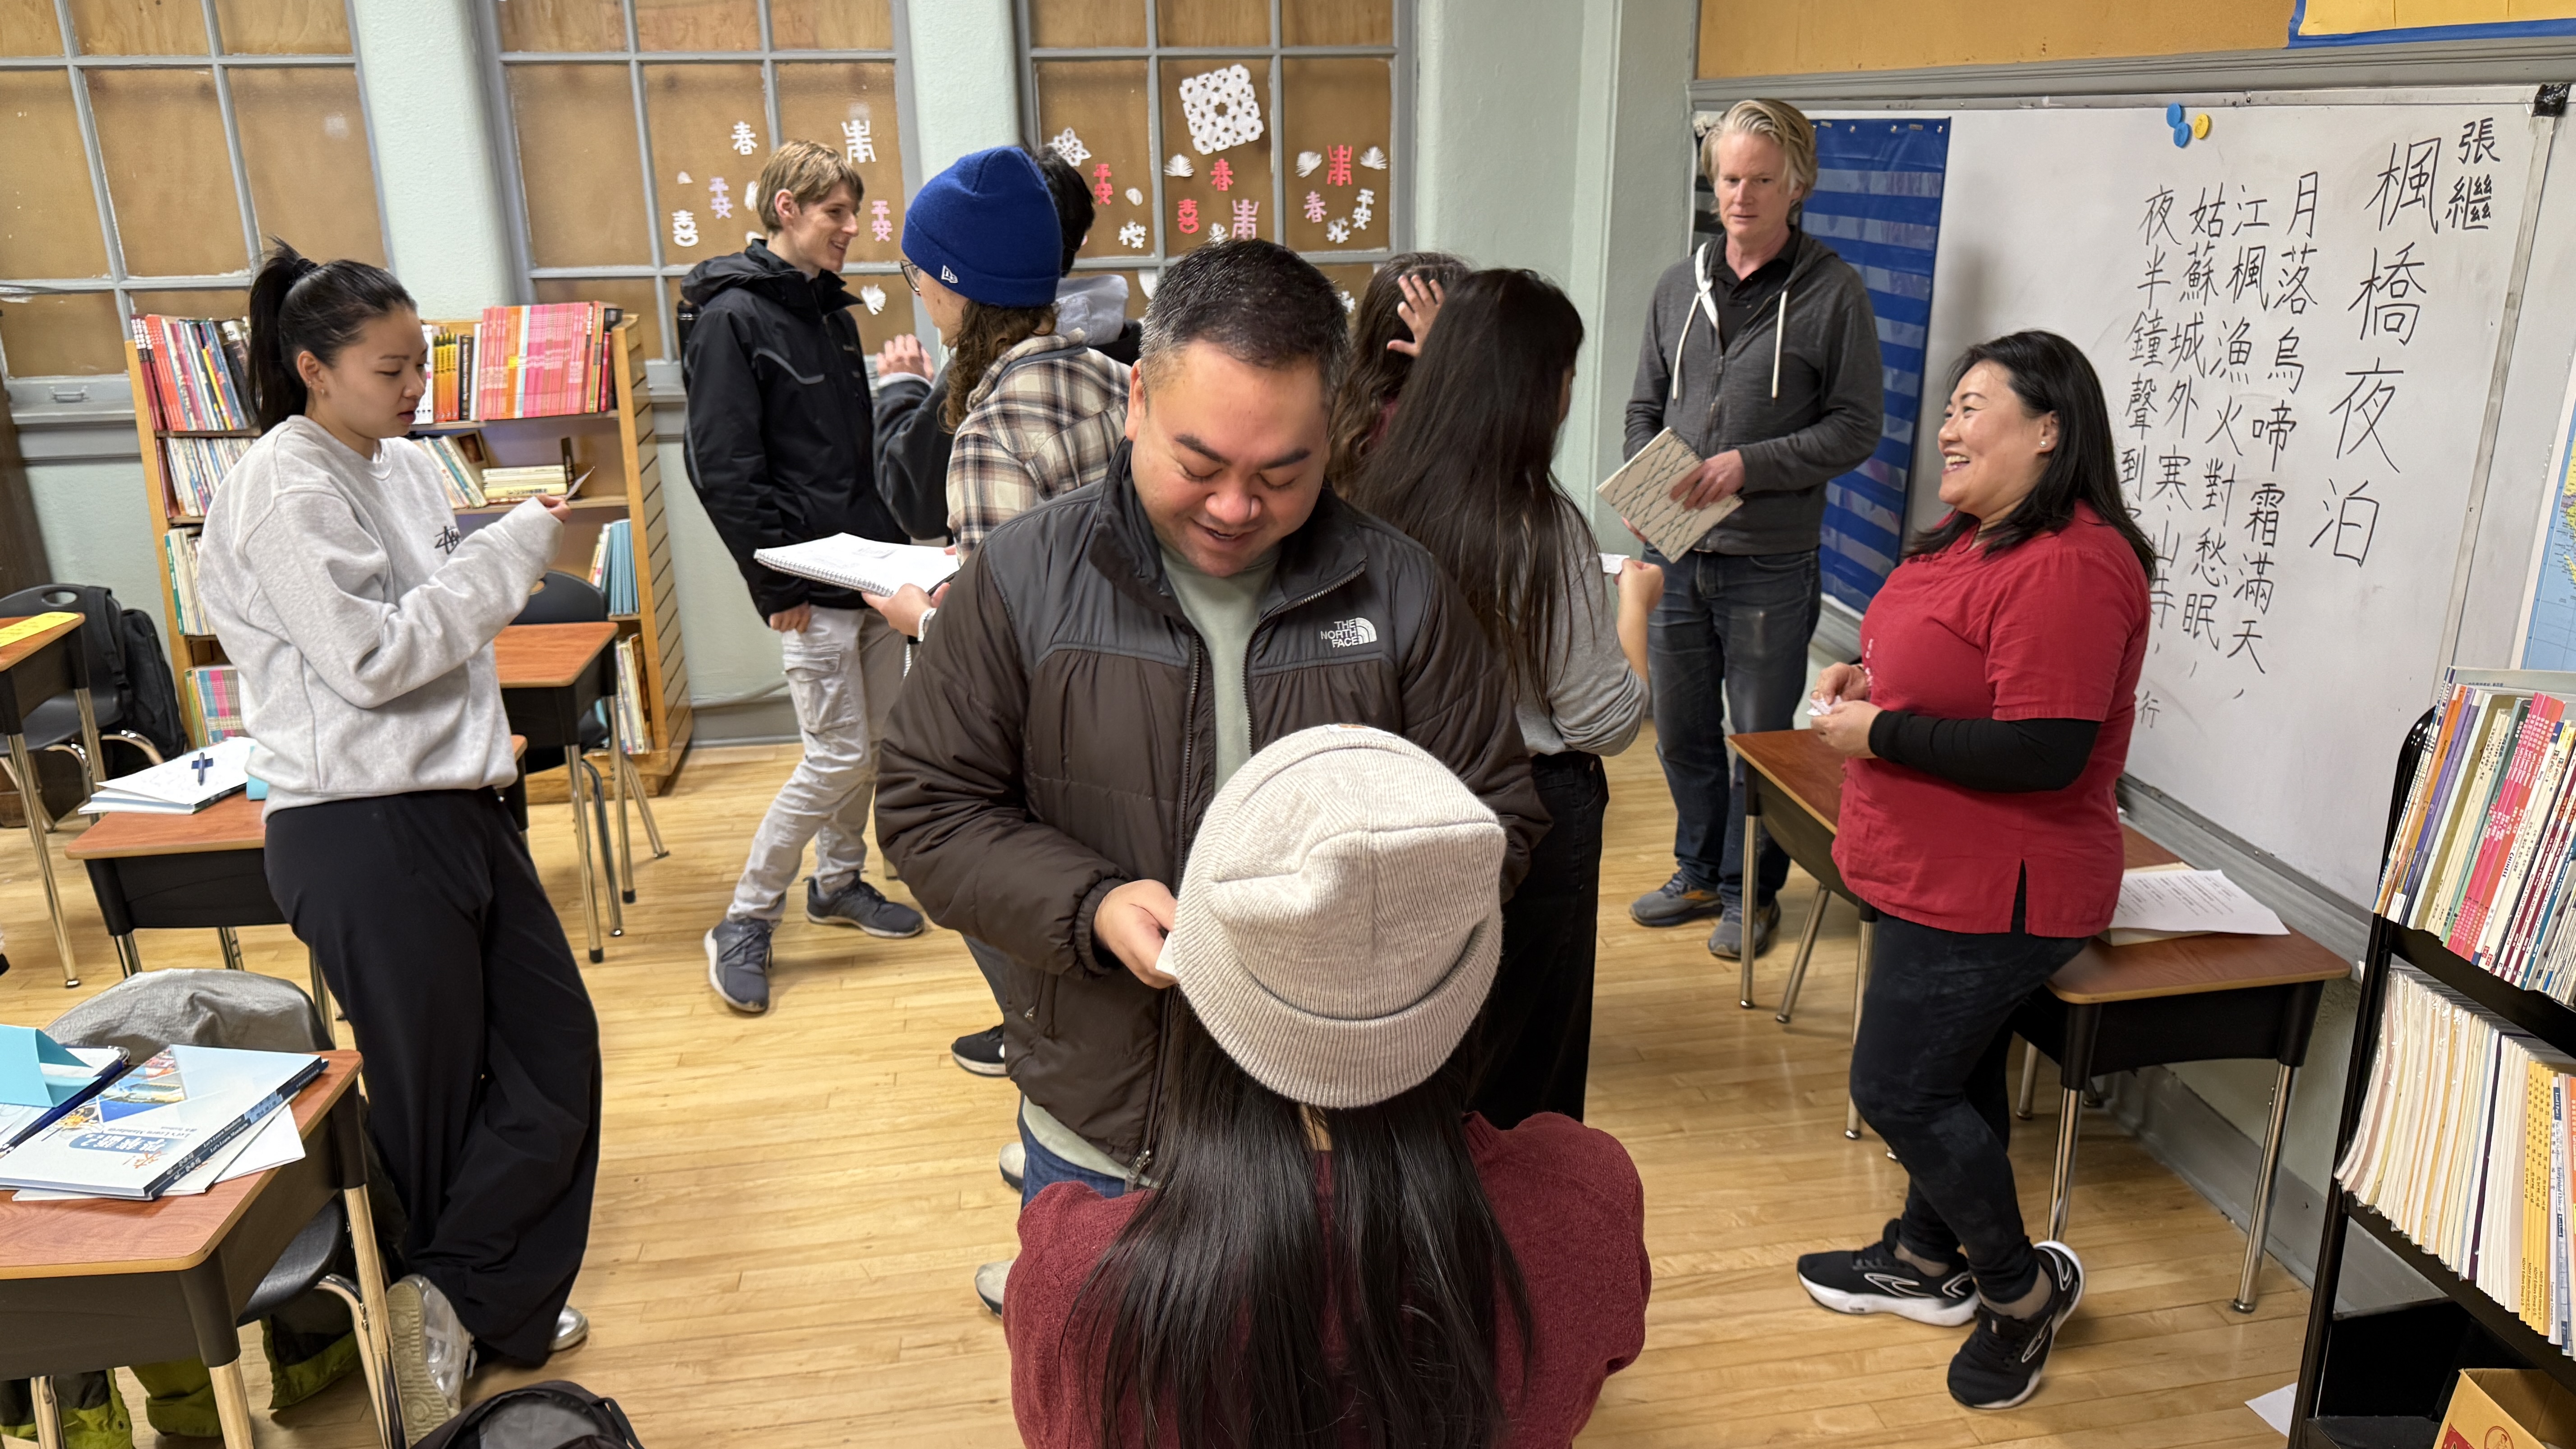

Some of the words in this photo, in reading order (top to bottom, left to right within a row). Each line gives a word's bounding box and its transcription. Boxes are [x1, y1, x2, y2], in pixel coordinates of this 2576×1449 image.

[731, 121, 758, 155] 春
[1210, 158, 1233, 192] 春
[2445, 117, 2500, 230] 張繼
[1304, 190, 1327, 223] 春
[2120, 184, 2182, 520] 夜半鐘聲到
[2309, 137, 2442, 567] 楓橋夜泊
[1320, 628, 1357, 640] NORTH
[1334, 619, 1356, 630] THE
[1332, 636, 1358, 648] FACE
[2502, 852, 2514, 878] CHINESE
